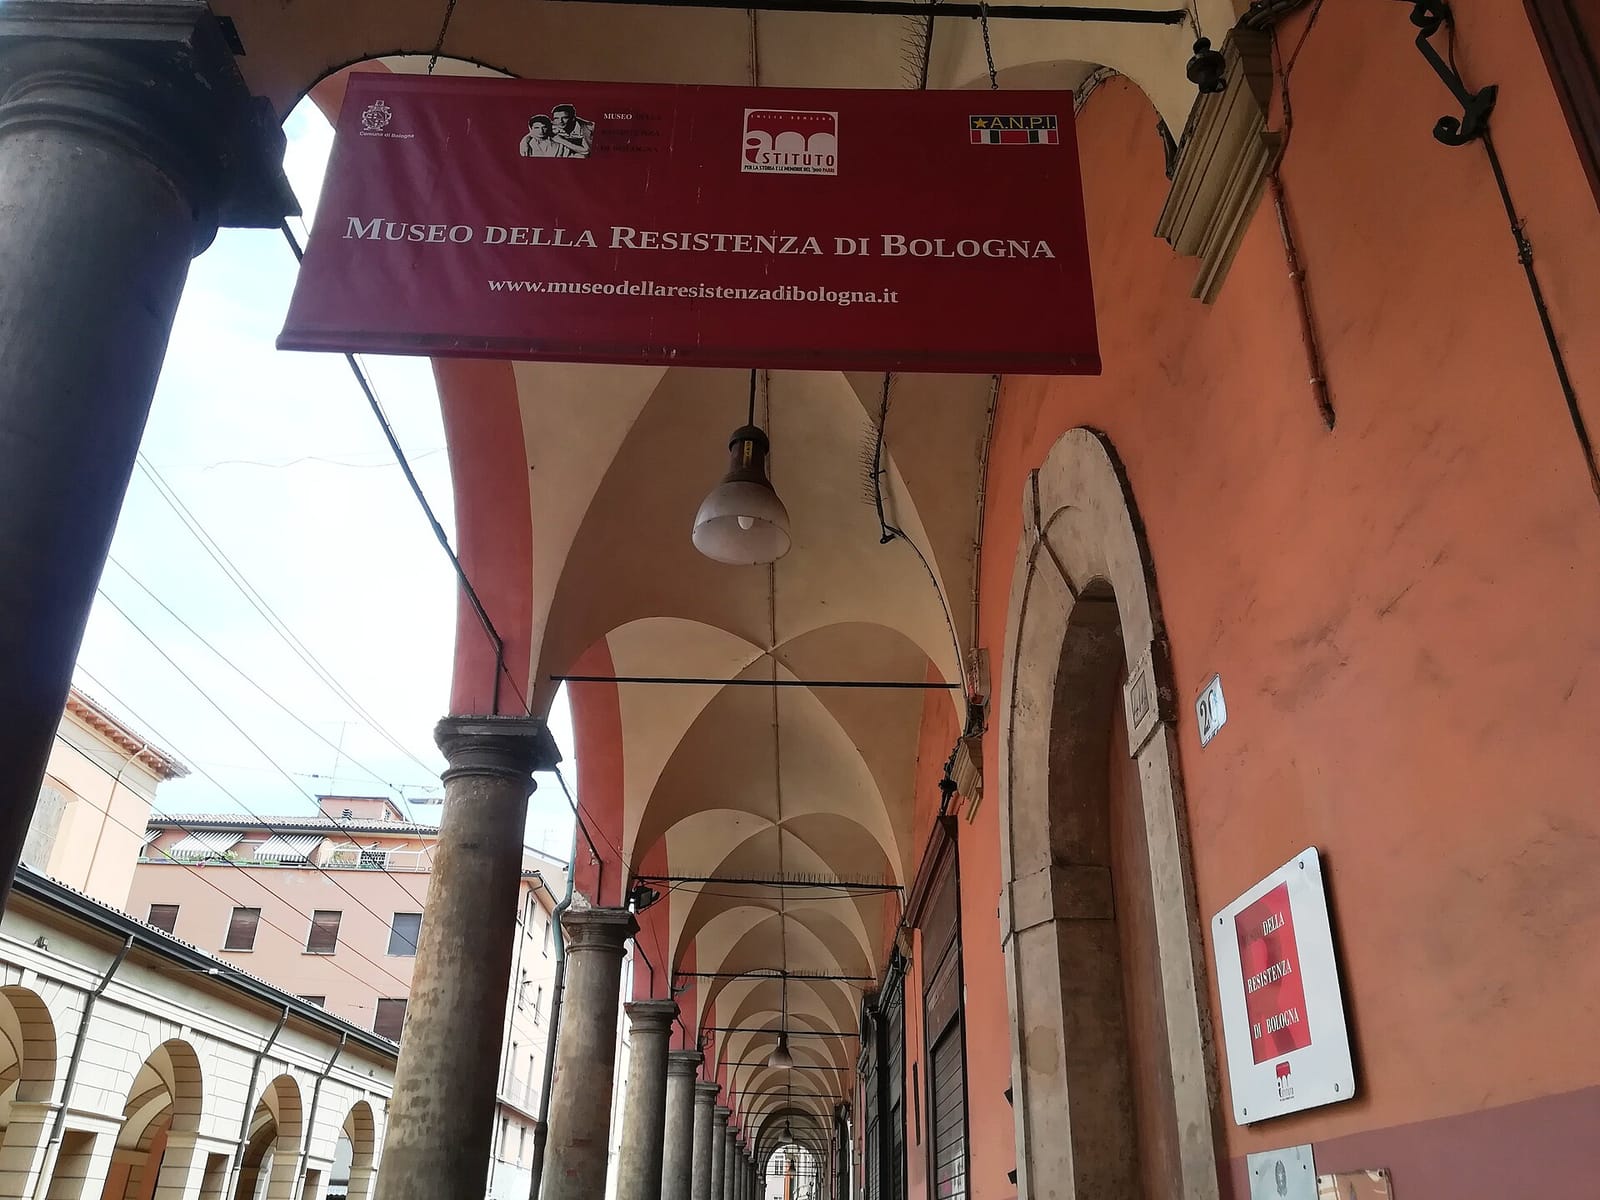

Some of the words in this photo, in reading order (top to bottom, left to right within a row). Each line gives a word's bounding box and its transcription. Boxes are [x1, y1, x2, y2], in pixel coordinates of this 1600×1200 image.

[603, 112, 633, 120] MUSEO
[342, 216, 474, 244] MUSEO
[483, 226, 598, 249] DELLA
[609, 226, 824, 255] RESISTENZA
[834, 237, 870, 256] DI
[881, 234, 1056, 259] BOLOGNA
[487, 279, 899, 307] www.museodellaresistenzadibologna.it
[1262, 911, 1285, 936] DELLA
[1247, 958, 1293, 994] RESISTENZA
[1253, 1022, 1262, 1040] DI
[1266, 1007, 1300, 1035] BOLOGNA
